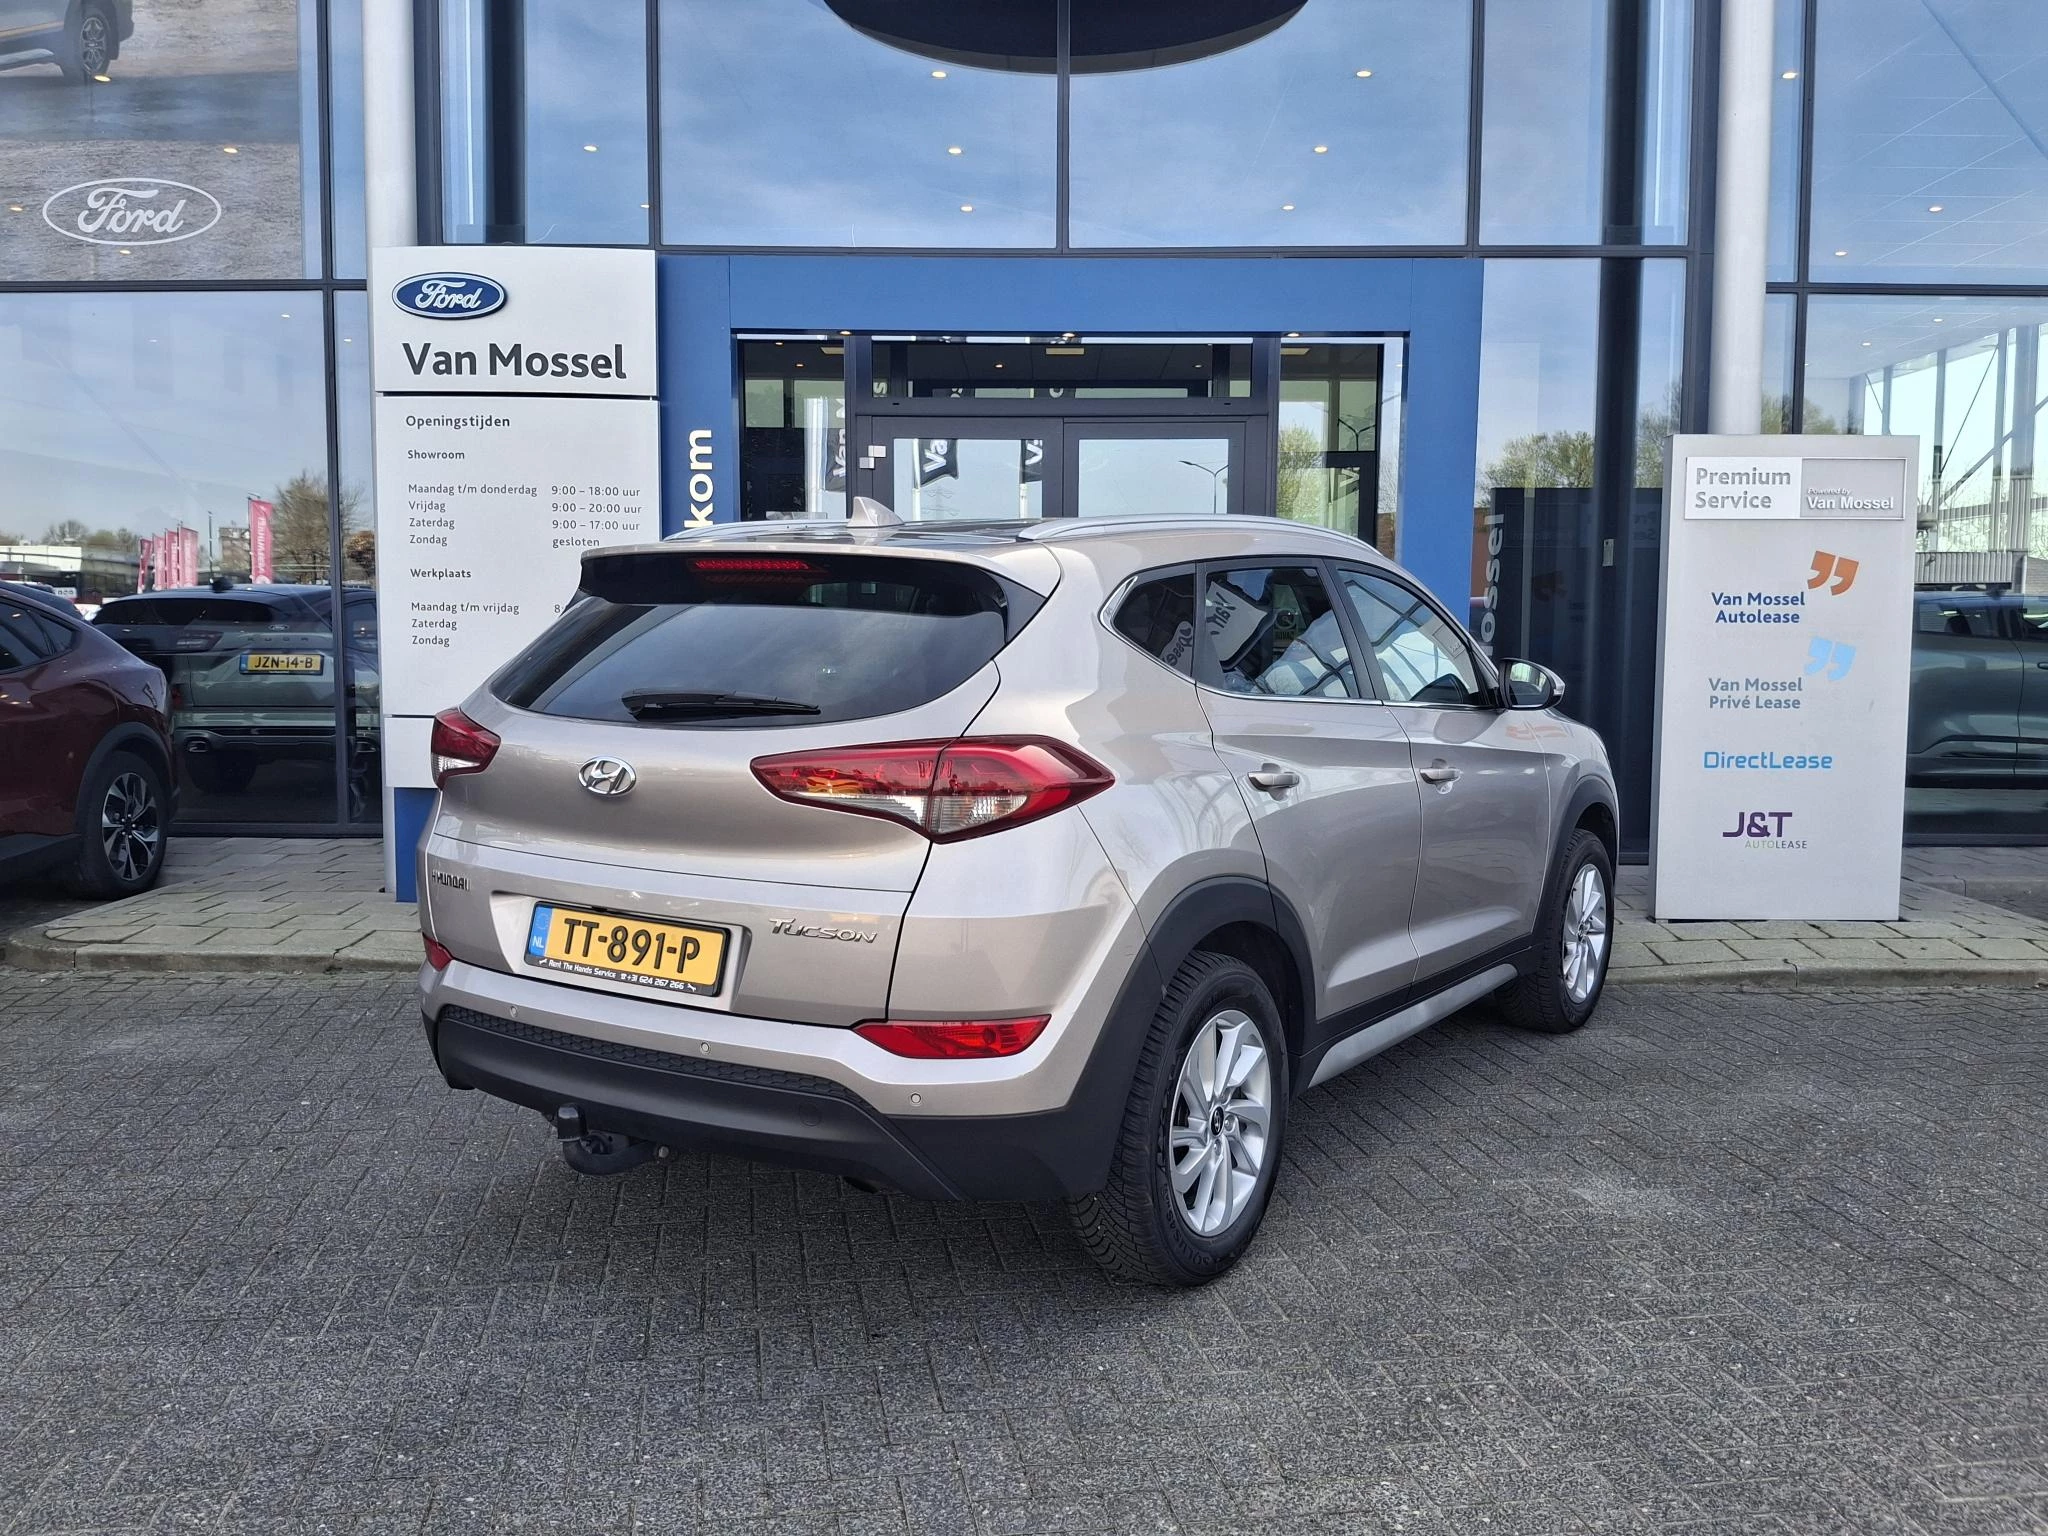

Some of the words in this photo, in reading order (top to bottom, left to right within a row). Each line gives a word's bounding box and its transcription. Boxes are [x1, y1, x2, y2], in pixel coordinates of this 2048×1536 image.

[77, 187, 186, 233] Ford
[414, 279, 483, 309] Ford
[402, 343, 477, 375] Van
[489, 343, 627, 379] Mossel
[405, 415, 511, 430] Openingstijden
[407, 450, 465, 460] Showroom
[1696, 467, 1791, 485] Premium
[408, 484, 455, 496] Maandag
[458, 484, 477, 494] t/m
[480, 484, 538, 497] donderdag
[551, 485, 576, 495] 9:00
[588, 486, 619, 496] 18:00
[408, 501, 446, 513] Vrijdag
[551, 503, 577, 512] 9:00
[588, 504, 621, 513] 20:00
[1695, 491, 1772, 509] Service
[1807, 496, 1836, 509] Van
[1840, 496, 1894, 510] Mossel
[409, 518, 455, 530] Zaterdag
[552, 520, 577, 529] 9:00
[589, 521, 619, 530] 17:00
[409, 534, 448, 547] Zondag
[552, 537, 600, 548] gesloten
[410, 568, 472, 579] Werkplaats
[1711, 592, 1742, 605] Van
[1747, 592, 1806, 606] Mossel
[411, 602, 457, 614] Maandag
[460, 602, 480, 612] t/m
[483, 603, 520, 615] vrijdag
[1715, 609, 1800, 623] Autolease
[411, 618, 457, 631] Zaterdag
[412, 635, 450, 647] Zondag
[254, 656, 313, 668] JZN-14-B
[1708, 678, 1740, 691] Van
[1745, 677, 1803, 691] Mossel
[1709, 695, 1751, 709] Privé
[1756, 696, 1801, 709] Lease
[1703, 751, 1833, 769] DirectLease
[1722, 811, 1793, 838] J&T
[1744, 840, 1808, 849] AUTOLEASE
[532, 936, 544, 949] NL
[564, 917, 701, 974] TT-891-P
[548, 960, 562, 969] Rent
[563, 962, 574, 971] The
[574, 964, 592, 974] Hands
[594, 968, 617, 979] Service
[639, 976, 653, 985] 624
[654, 978, 668, 987] 267
